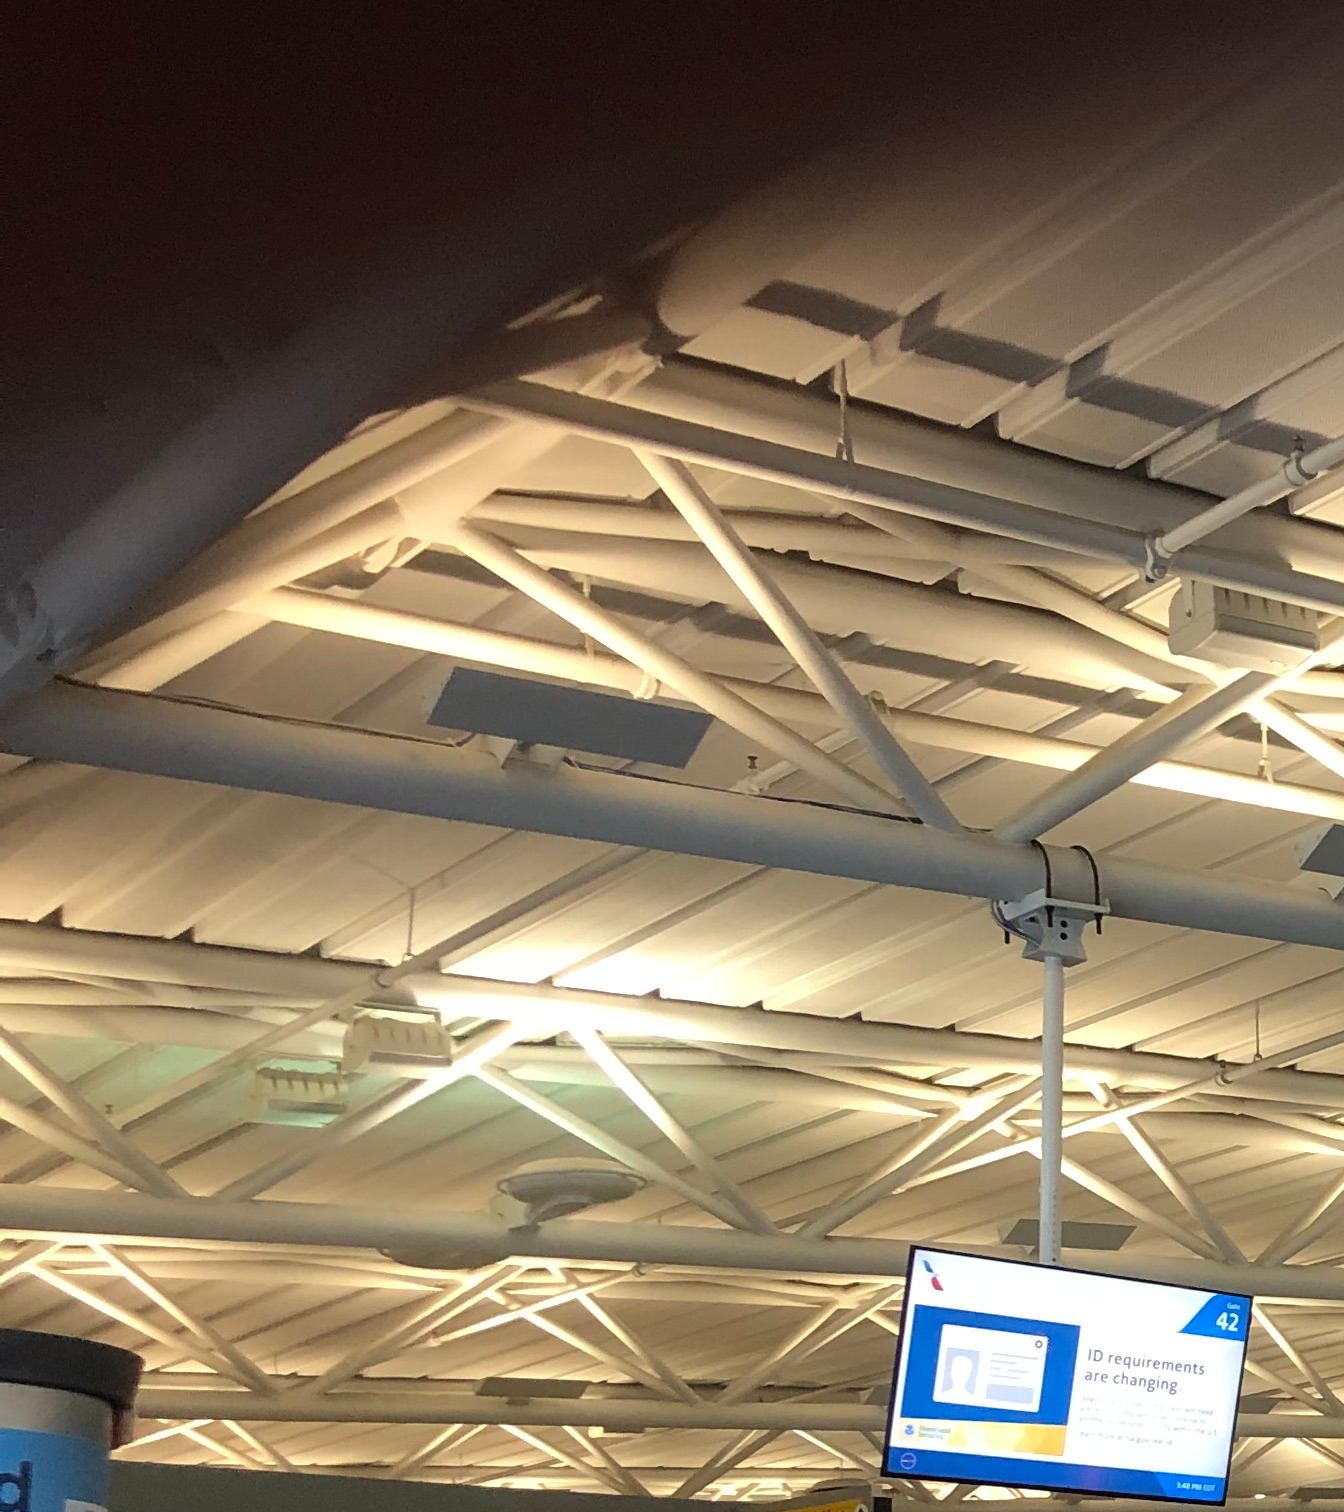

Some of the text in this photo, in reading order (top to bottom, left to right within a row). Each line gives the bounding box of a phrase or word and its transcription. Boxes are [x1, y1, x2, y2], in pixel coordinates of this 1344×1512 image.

[1216, 1311, 1240, 1332] 42
[1087, 1348, 1205, 1376] ID requirements
[1084, 1371, 1108, 1384] are
